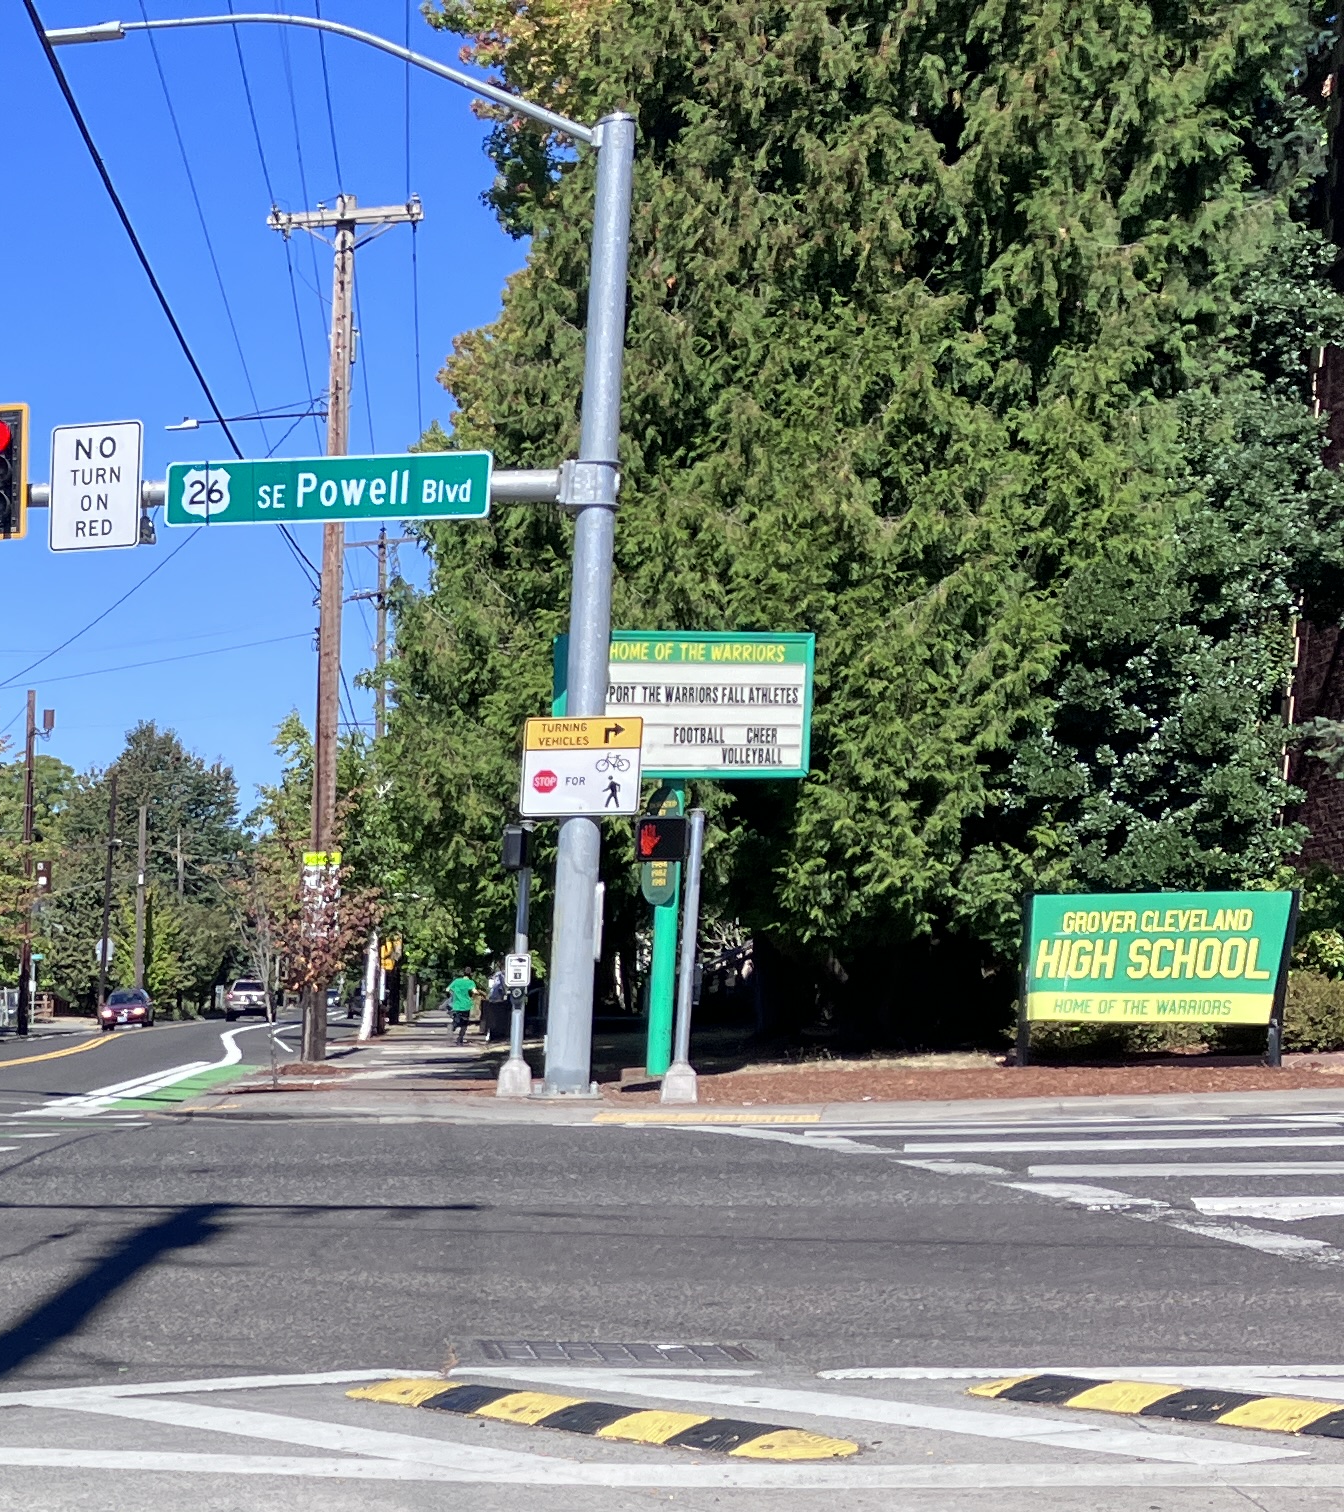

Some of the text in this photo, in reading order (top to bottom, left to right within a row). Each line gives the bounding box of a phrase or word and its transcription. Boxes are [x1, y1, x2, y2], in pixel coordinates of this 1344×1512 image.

[75, 436, 116, 460] NO
[71, 466, 121, 486] TURN
[188, 479, 224, 505] 26
[257, 469, 472, 508] SE Powell Blvd
[81, 494, 108, 511] ON
[75, 519, 112, 537] RED
[609, 642, 786, 662] HOME OF THE WARRIORS
[642, 686, 661, 703] THE
[665, 686, 718, 704] WARRIORS
[721, 686, 746, 704] FALL
[748, 687, 799, 704] ATHLETES
[542, 722, 588, 733] TURNING
[673, 727, 778, 745] FOOTBALL CHEER
[538, 736, 590, 746] VEHICLES
[721, 747, 783, 764] VOLLEYBALL
[533, 776, 586, 787] STOP FOR
[1062, 908, 1253, 933] GROVER CLEVELAND
[1035, 937, 1270, 980] HIGH SCHOOL
[1053, 998, 1233, 1016] HOME OF THE WARRIORS
